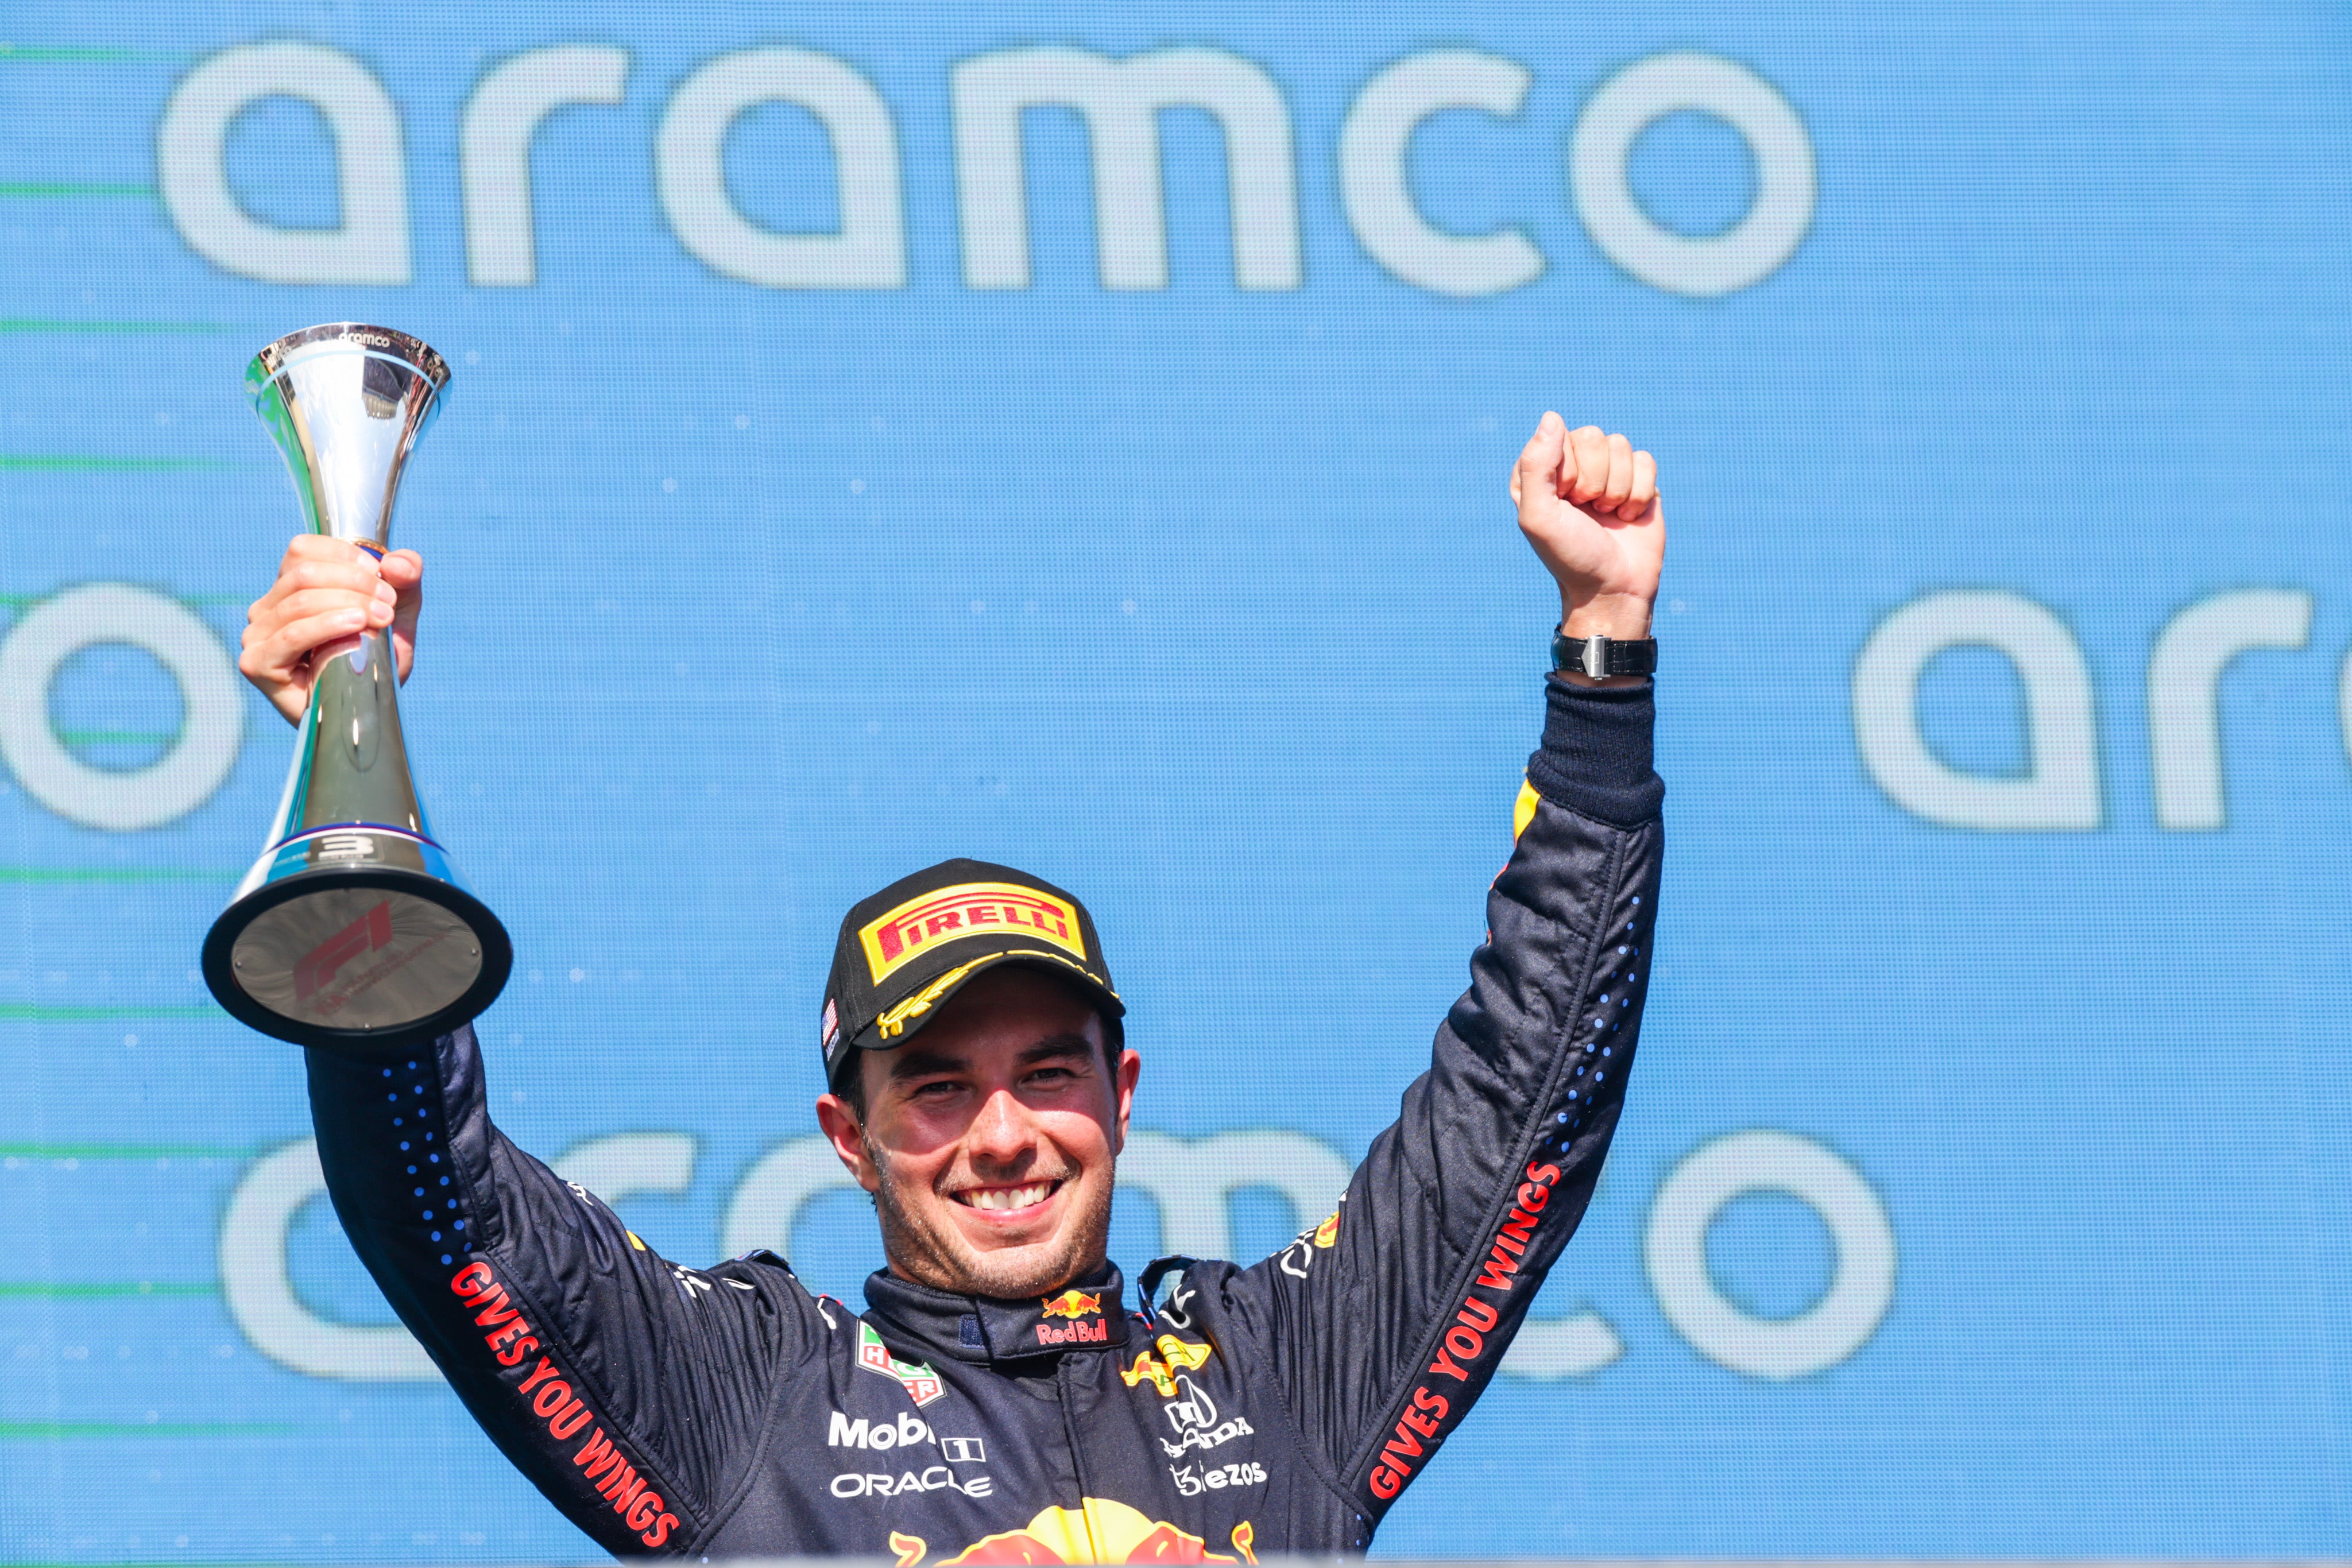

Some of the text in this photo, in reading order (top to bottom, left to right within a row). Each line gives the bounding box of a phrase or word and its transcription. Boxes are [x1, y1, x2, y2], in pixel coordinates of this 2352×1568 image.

[158, 41, 1816, 295] aramco
[338, 332, 390, 348] aramco
[318, 835, 374, 858] 3
[877, 892, 1071, 963] PIRELLI
[1036, 1318, 1108, 1345] Red Bull
[1370, 1160, 1561, 1500] GIVES YOU WINGS
[450, 1262, 680, 1547] GIVES YOU WINGS
[953, 1439, 971, 1459] 1
[830, 1466, 993, 1499] ORACLE
